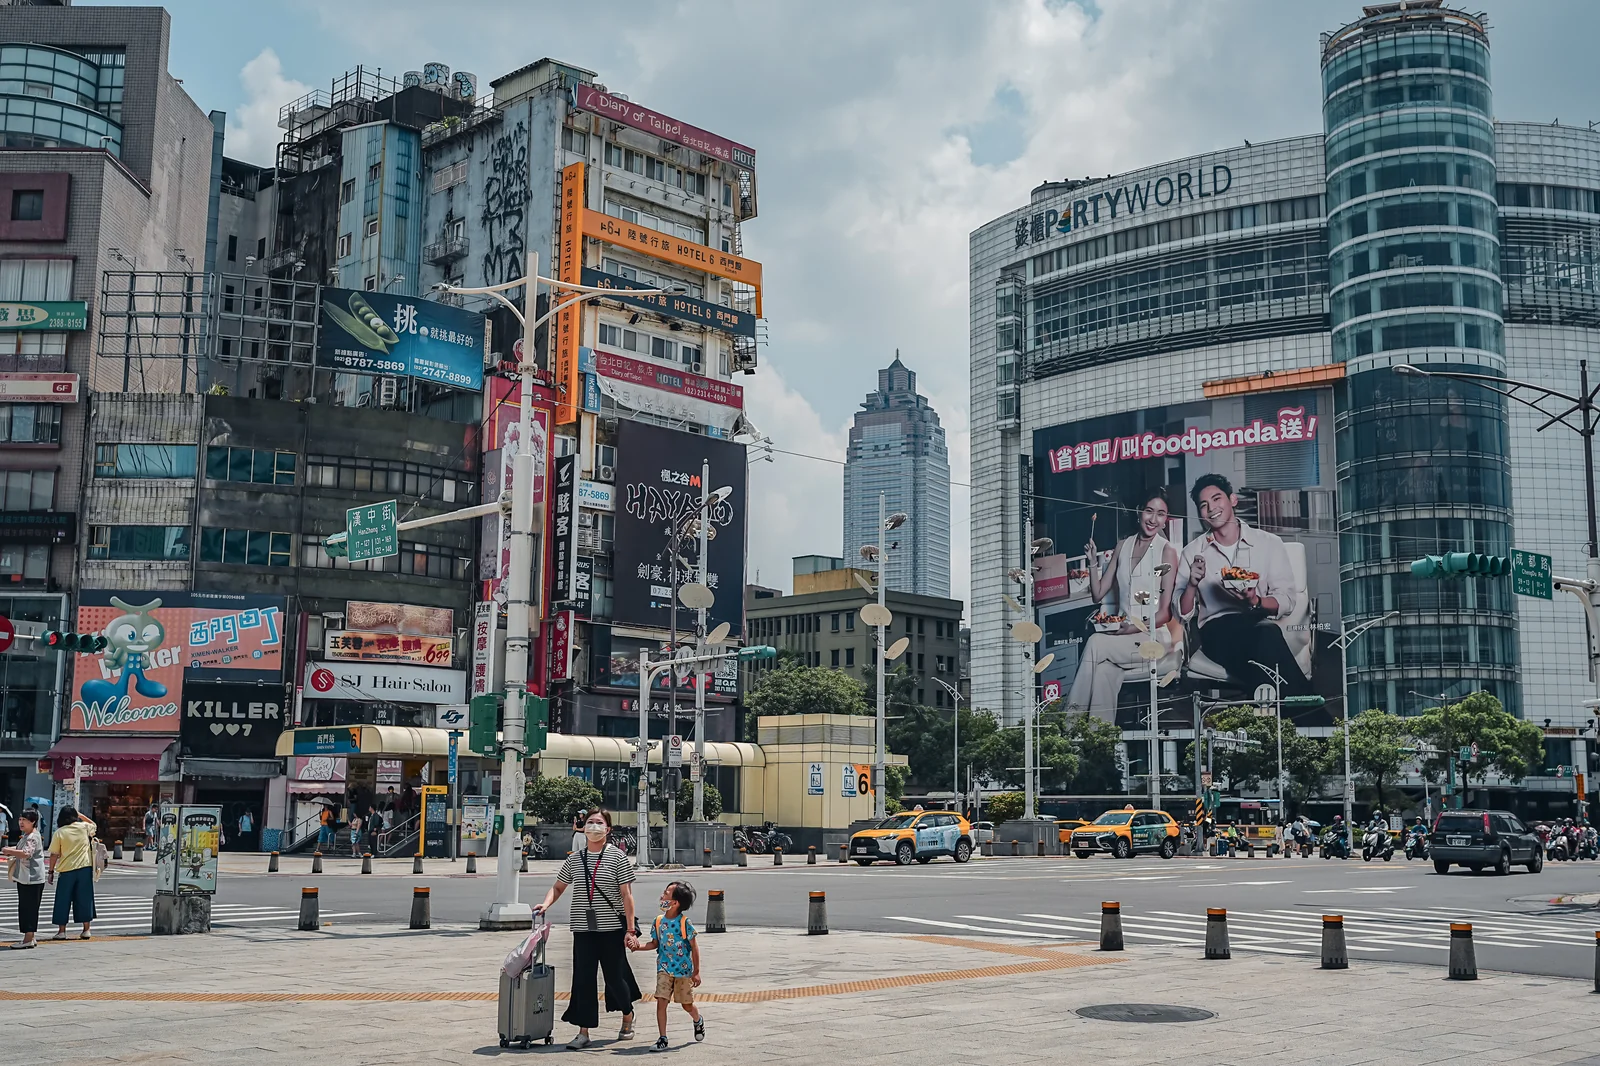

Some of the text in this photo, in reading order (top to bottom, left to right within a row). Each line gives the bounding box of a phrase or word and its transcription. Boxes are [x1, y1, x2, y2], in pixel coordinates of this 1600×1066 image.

[598, 95, 681, 136] Diary of Taipei
[628, 228, 670, 252] 陸號行旅
[564, 240, 572, 274] HOTEL
[678, 244, 715, 265] HOTEL 6
[719, 256, 742, 271] 西門館
[393, 303, 418, 335] 挑
[674, 299, 712, 319] HOTEL 6
[716, 310, 739, 325] 西門館
[49, 318, 82, 328] 2388-8155
[430, 327, 474, 348] 就挑最好的
[56, 384, 69, 392] 6F
[656, 373, 682, 388] HOTEL
[353, 504, 391, 527] 漢中街
[556, 493, 570, 537] 駭客
[1516, 553, 1548, 570] 成都路
[189, 606, 279, 647] 西門町
[476, 621, 489, 651] 按摩
[98, 645, 182, 680] Wker
[341, 674, 452, 693] SJ Hair Salon
[71, 695, 178, 730] Welcome
[187, 700, 279, 720] KILLER
[242, 723, 253, 737] 7
[317, 734, 335, 744] 西門站
[350, 733, 357, 748] 6
[858, 773, 869, 795] 6
